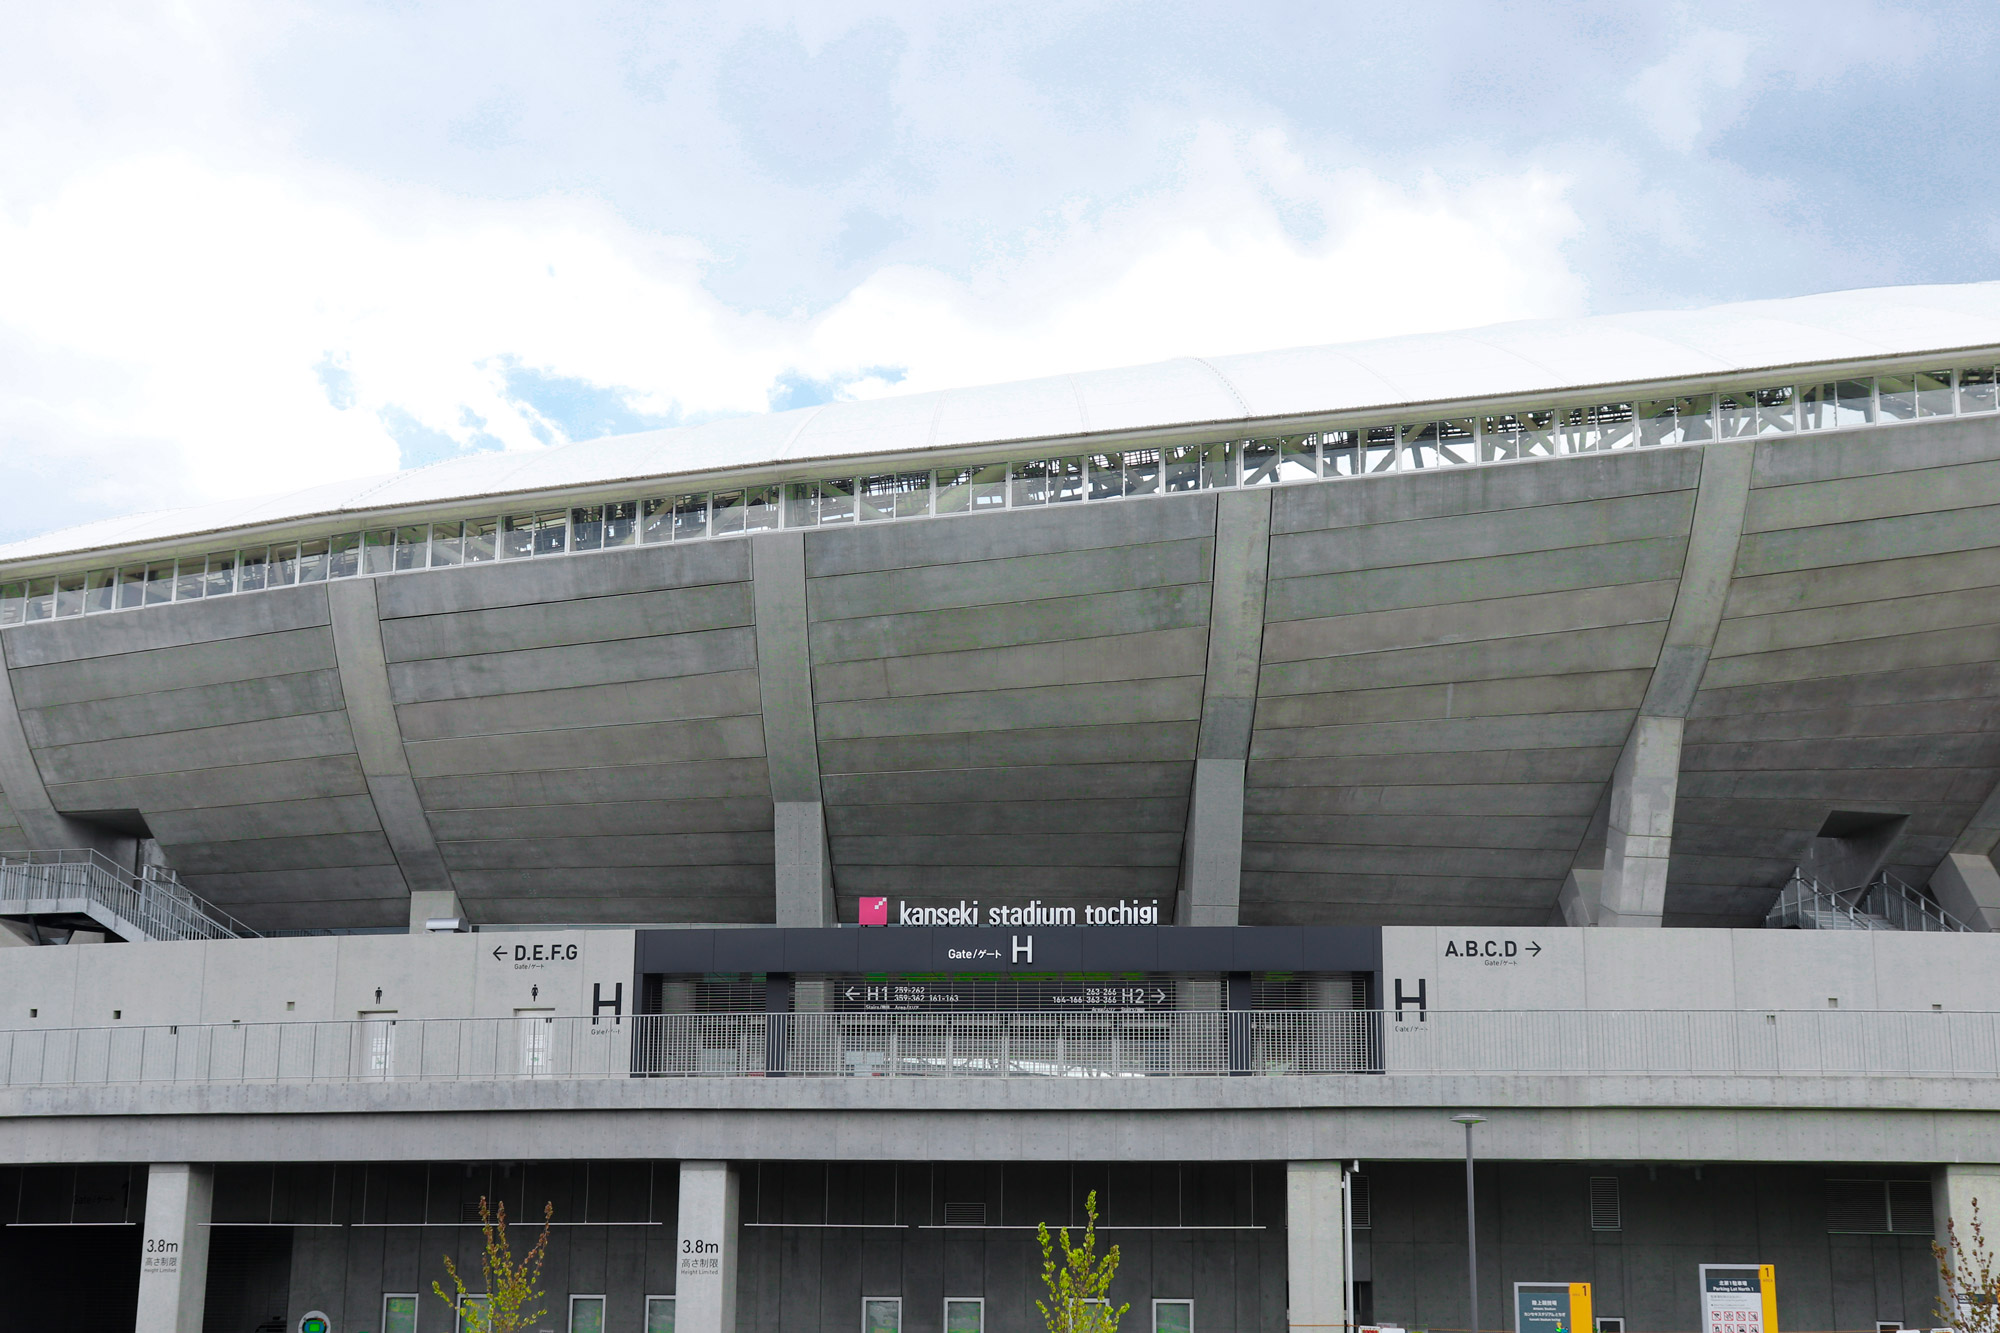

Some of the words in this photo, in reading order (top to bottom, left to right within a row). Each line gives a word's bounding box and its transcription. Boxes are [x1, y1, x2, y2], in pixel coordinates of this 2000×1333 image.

[900, 900, 979, 925] kanseki
[988, 900, 1076, 925] stadium
[1085, 900, 1158, 925] tochigi
[515, 944, 578, 961] D.E.F.G
[948, 948, 1002, 959] Gate/ゲート
[1012, 935, 1033, 963] H
[1445, 940, 1517, 957] A.B.C.D
[867, 986, 888, 1001] H1
[1122, 988, 1144, 1004] H2
[1395, 978, 1426, 1022] H
[592, 982, 622, 1025] H
[146, 1239, 178, 1253] 3.8m
[682, 1240, 719, 1253] 3.8m
[145, 1257, 177, 1267] 高さ制限
[681, 1258, 718, 1268] 高さ制限
